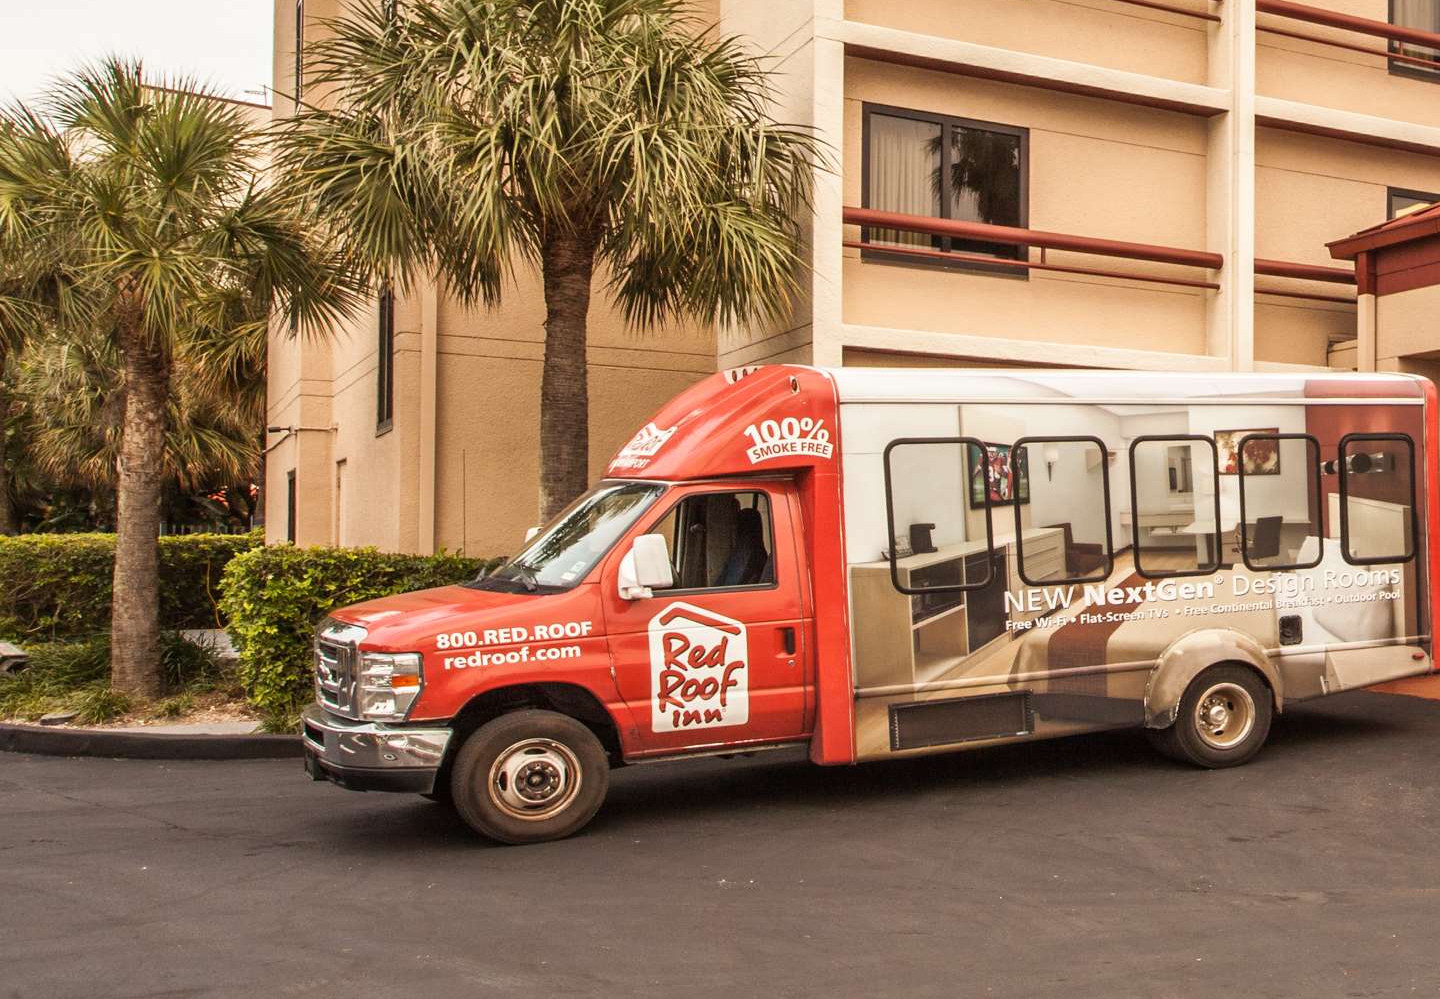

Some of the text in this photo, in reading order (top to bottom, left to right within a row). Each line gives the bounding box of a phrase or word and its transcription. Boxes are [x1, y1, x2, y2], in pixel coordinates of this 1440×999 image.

[743, 417, 829, 447] 100%
[752, 441, 829, 459] SMOKE FREE
[1004, 586, 1075, 613] NEW
[1232, 571, 1316, 598] Design
[1323, 568, 1400, 589] Rooms
[1005, 620, 1032, 631] Free
[1035, 616, 1068, 629] Wi-Fi
[1080, 610, 1146, 625] Flat-Screen
[1149, 607, 1169, 619] TVs
[1184, 606, 1208, 616] Free
[1210, 600, 1273, 614] Continental
[1335, 593, 1377, 604] Outdoor
[1380, 591, 1401, 600] Pool
[436, 621, 592, 649] 800.RED.ROOF
[662, 632, 729, 672] Red
[444, 646, 581, 670] redroof.com
[657, 660, 745, 713] Roof
